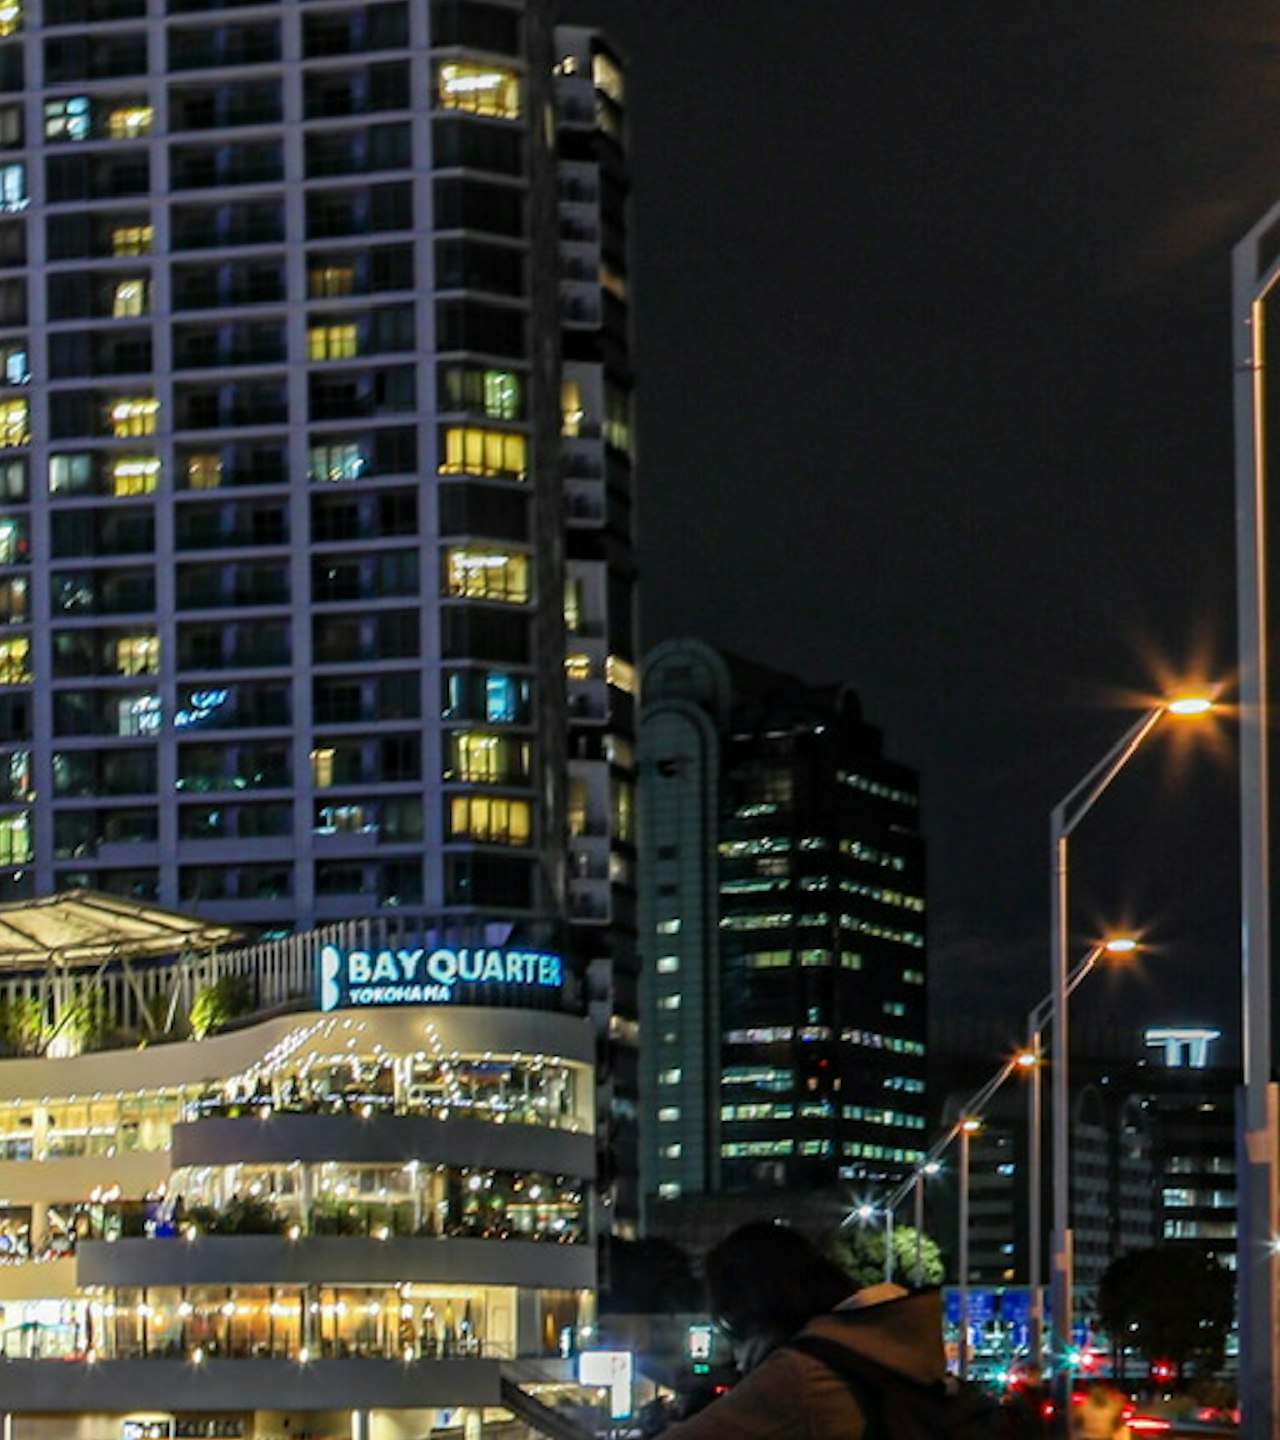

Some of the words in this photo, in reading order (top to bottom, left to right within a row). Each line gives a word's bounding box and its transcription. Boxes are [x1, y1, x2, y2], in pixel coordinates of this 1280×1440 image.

[348, 948, 424, 984] BAY
[427, 948, 562, 987] QUARTER
[349, 984, 451, 1005] YOKOHAMA
